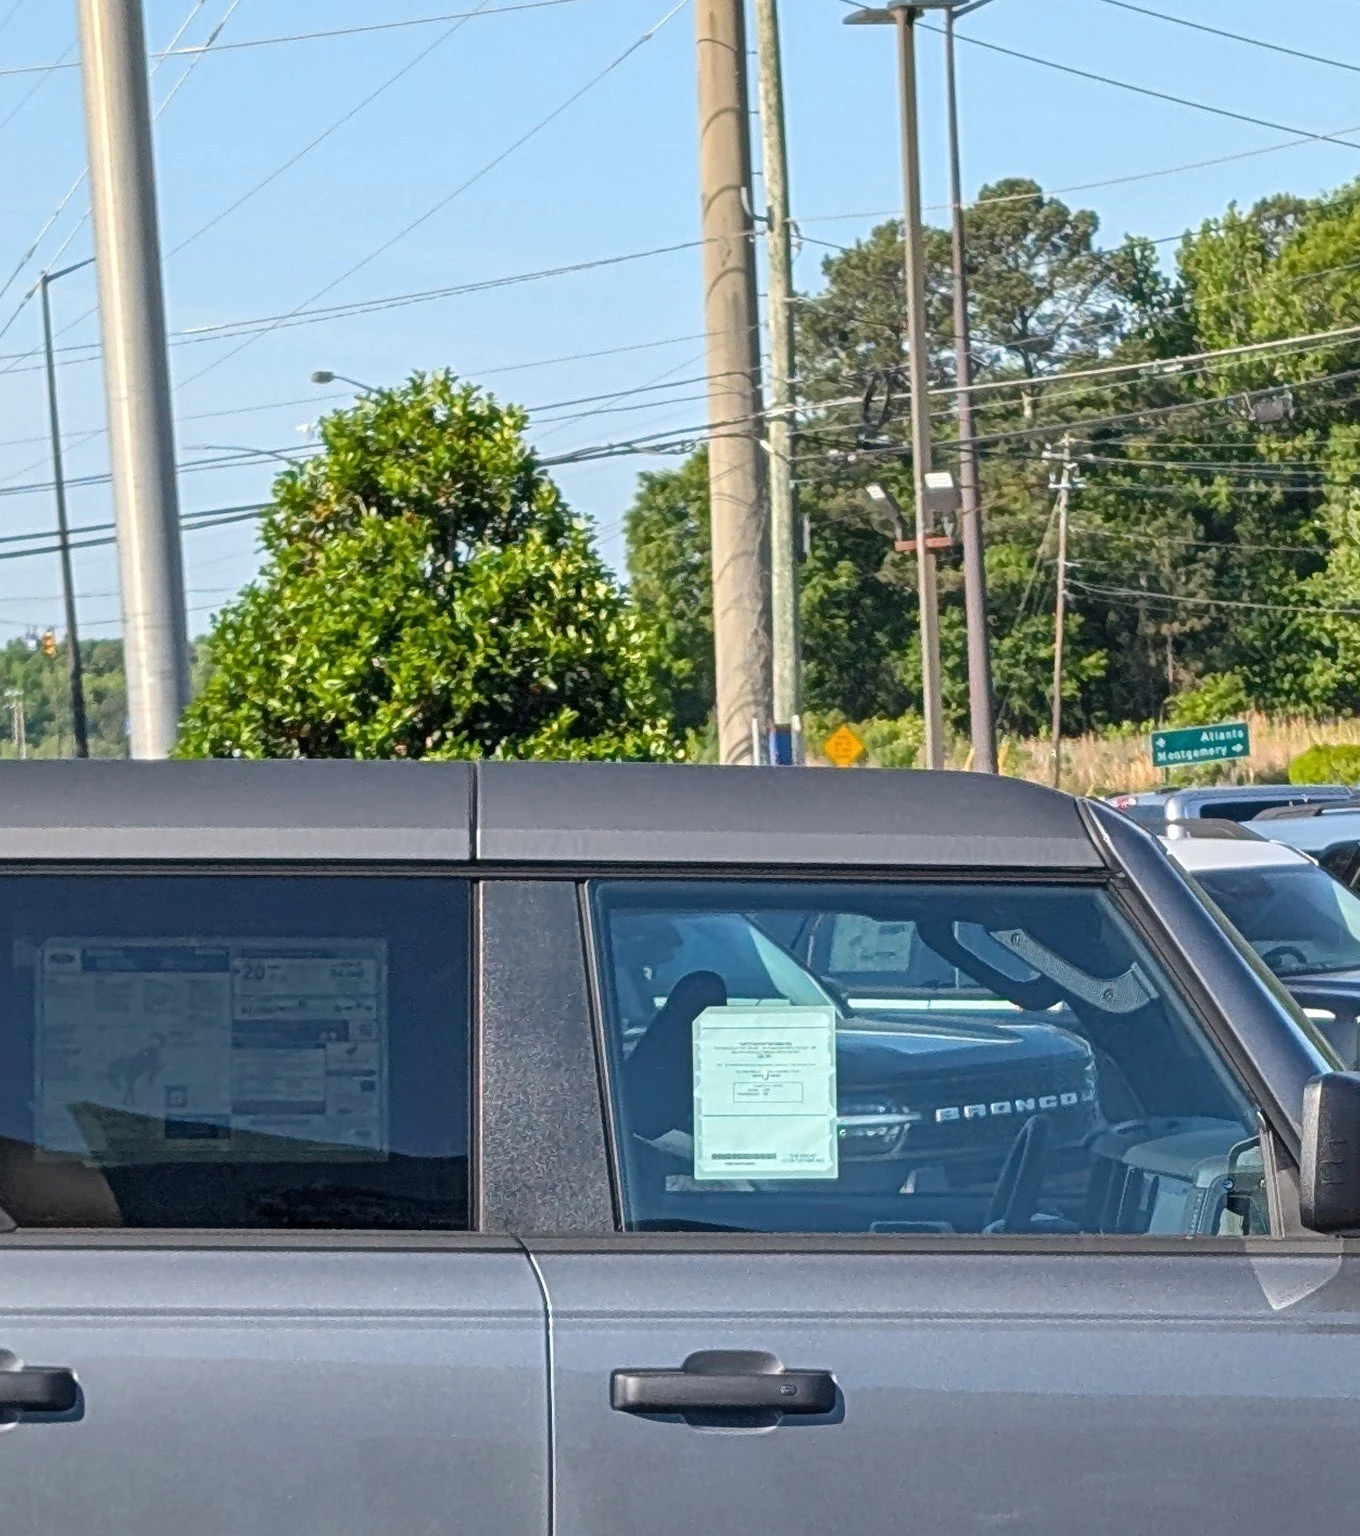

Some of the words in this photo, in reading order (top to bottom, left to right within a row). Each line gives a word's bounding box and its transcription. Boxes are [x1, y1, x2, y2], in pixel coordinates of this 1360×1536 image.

[1200, 729, 1244, 742] Atlanta
[1157, 746, 1228, 761] Montgomery
[936, 1093, 1078, 1122] BRONCO
